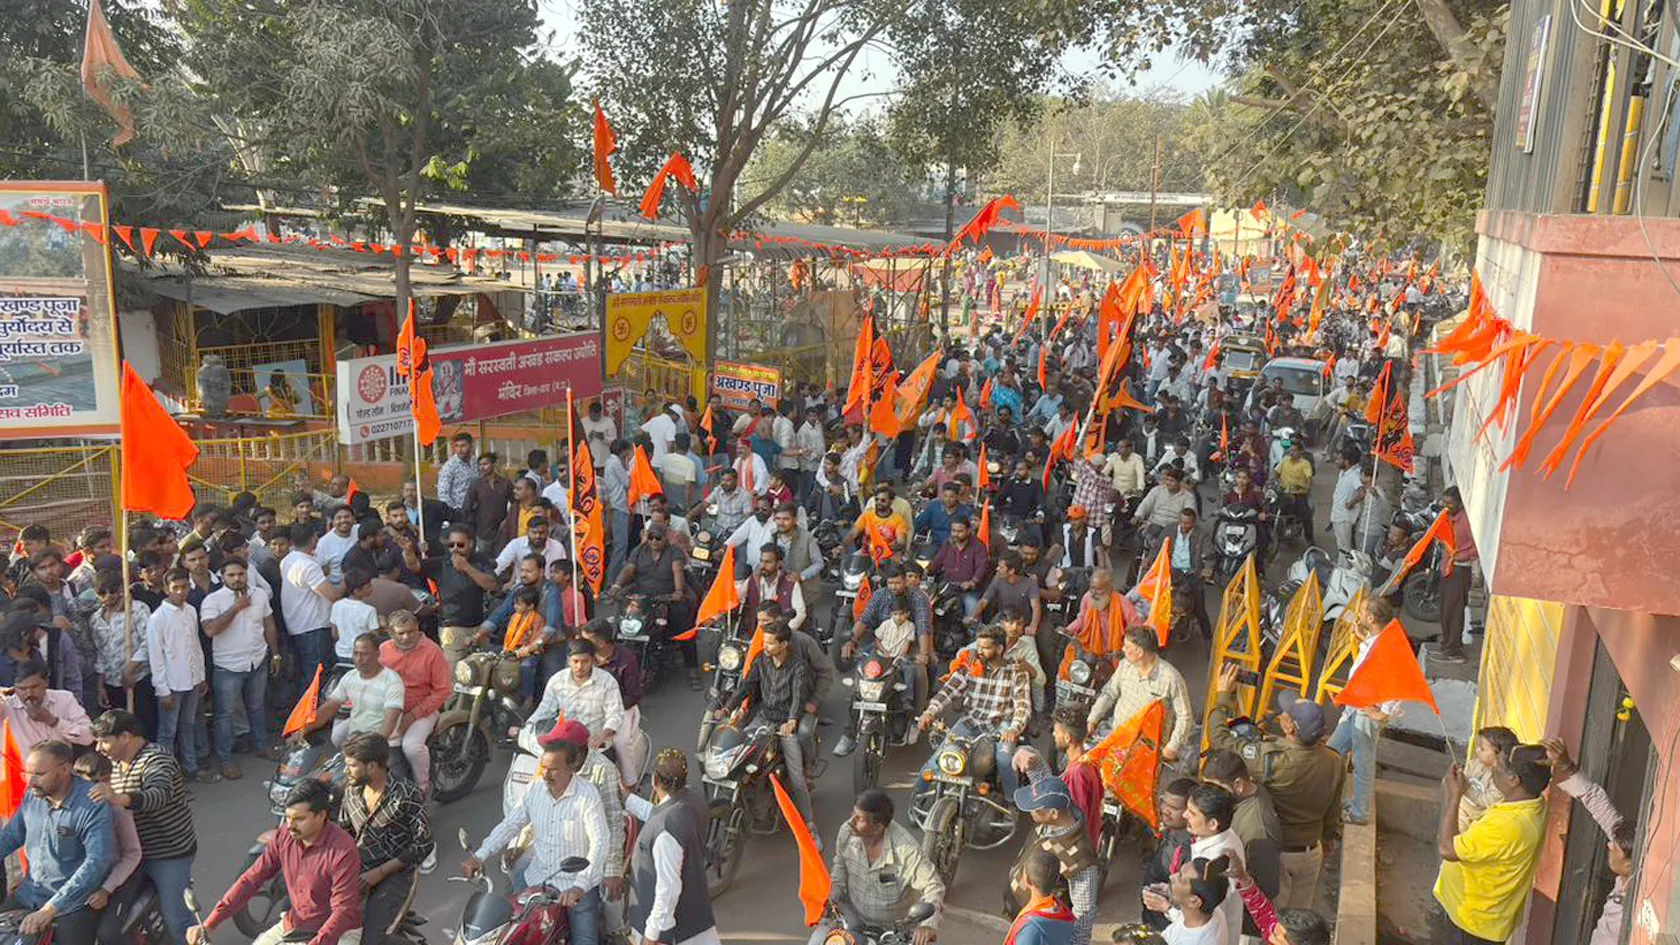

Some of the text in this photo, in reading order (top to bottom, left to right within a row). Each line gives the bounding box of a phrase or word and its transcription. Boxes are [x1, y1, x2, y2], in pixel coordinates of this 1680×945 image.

[0, 299, 79, 316] खण्ड पूजा
[57, 318, 73, 332] से
[0, 338, 82, 359] ूर्यास्त तक
[464, 357, 476, 376] माँ
[479, 351, 517, 374] सरस्वती
[518, 348, 543, 369] अखंड
[498, 380, 521, 400] मंदिर
[716, 376, 776, 400] अखण्ड पूजा
[24, 403, 71, 419] समिति
